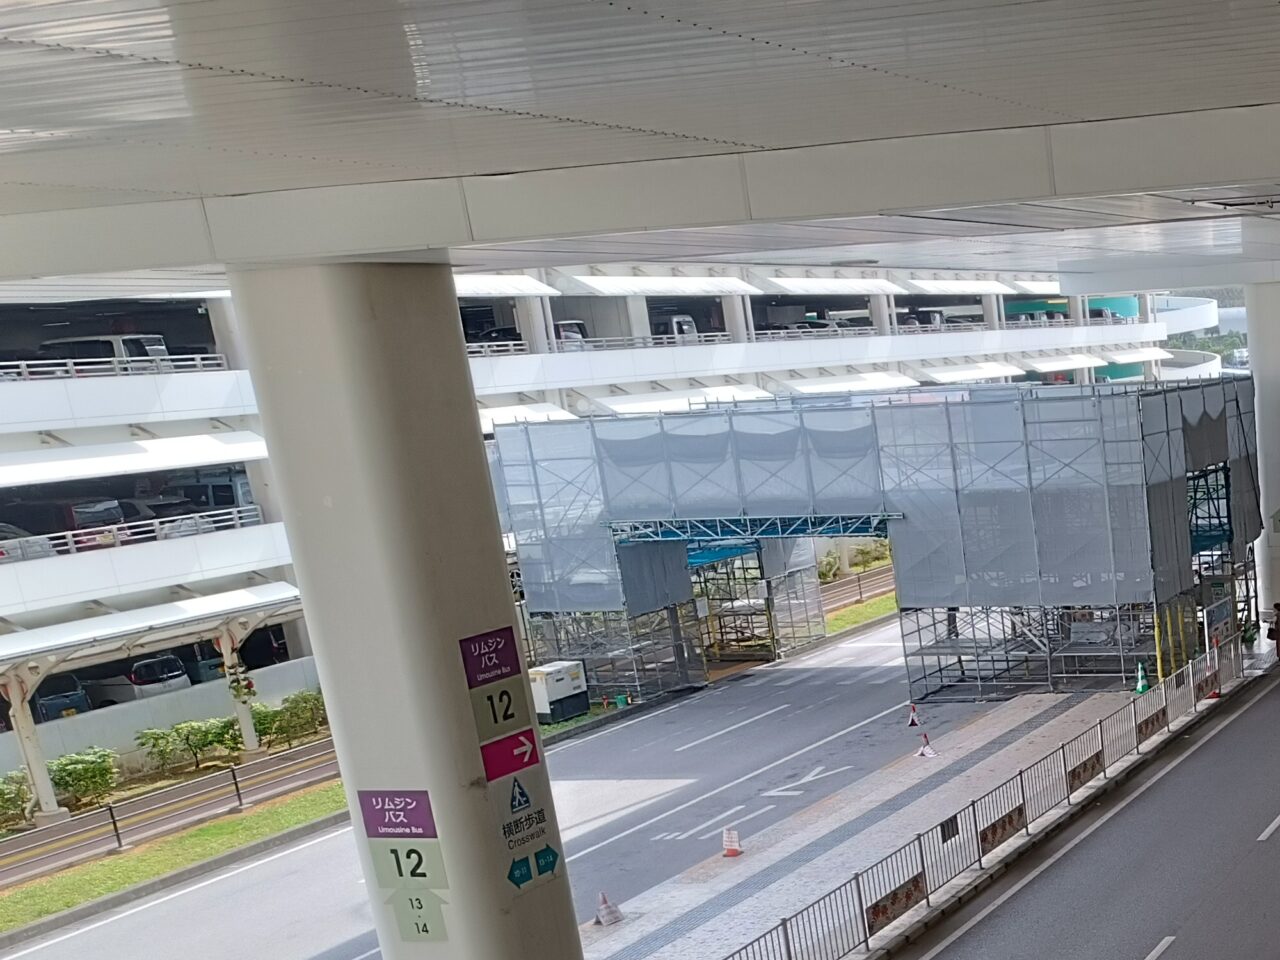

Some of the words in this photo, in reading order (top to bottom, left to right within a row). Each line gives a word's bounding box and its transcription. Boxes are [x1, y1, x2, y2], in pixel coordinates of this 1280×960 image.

[471, 637, 505, 656] リムジン
[481, 653, 499, 668] バス
[486, 689, 515, 724] 12
[372, 797, 417, 809] リムジン
[384, 811, 408, 823] バス
[502, 808, 547, 839] 横断歩道
[378, 826, 411, 834] Limousine
[411, 826, 423, 834] Bus
[507, 826, 547, 850] Crosswalk
[389, 848, 427, 878] 12
[408, 898, 423, 910] 13
[415, 922, 430, 934] 14
